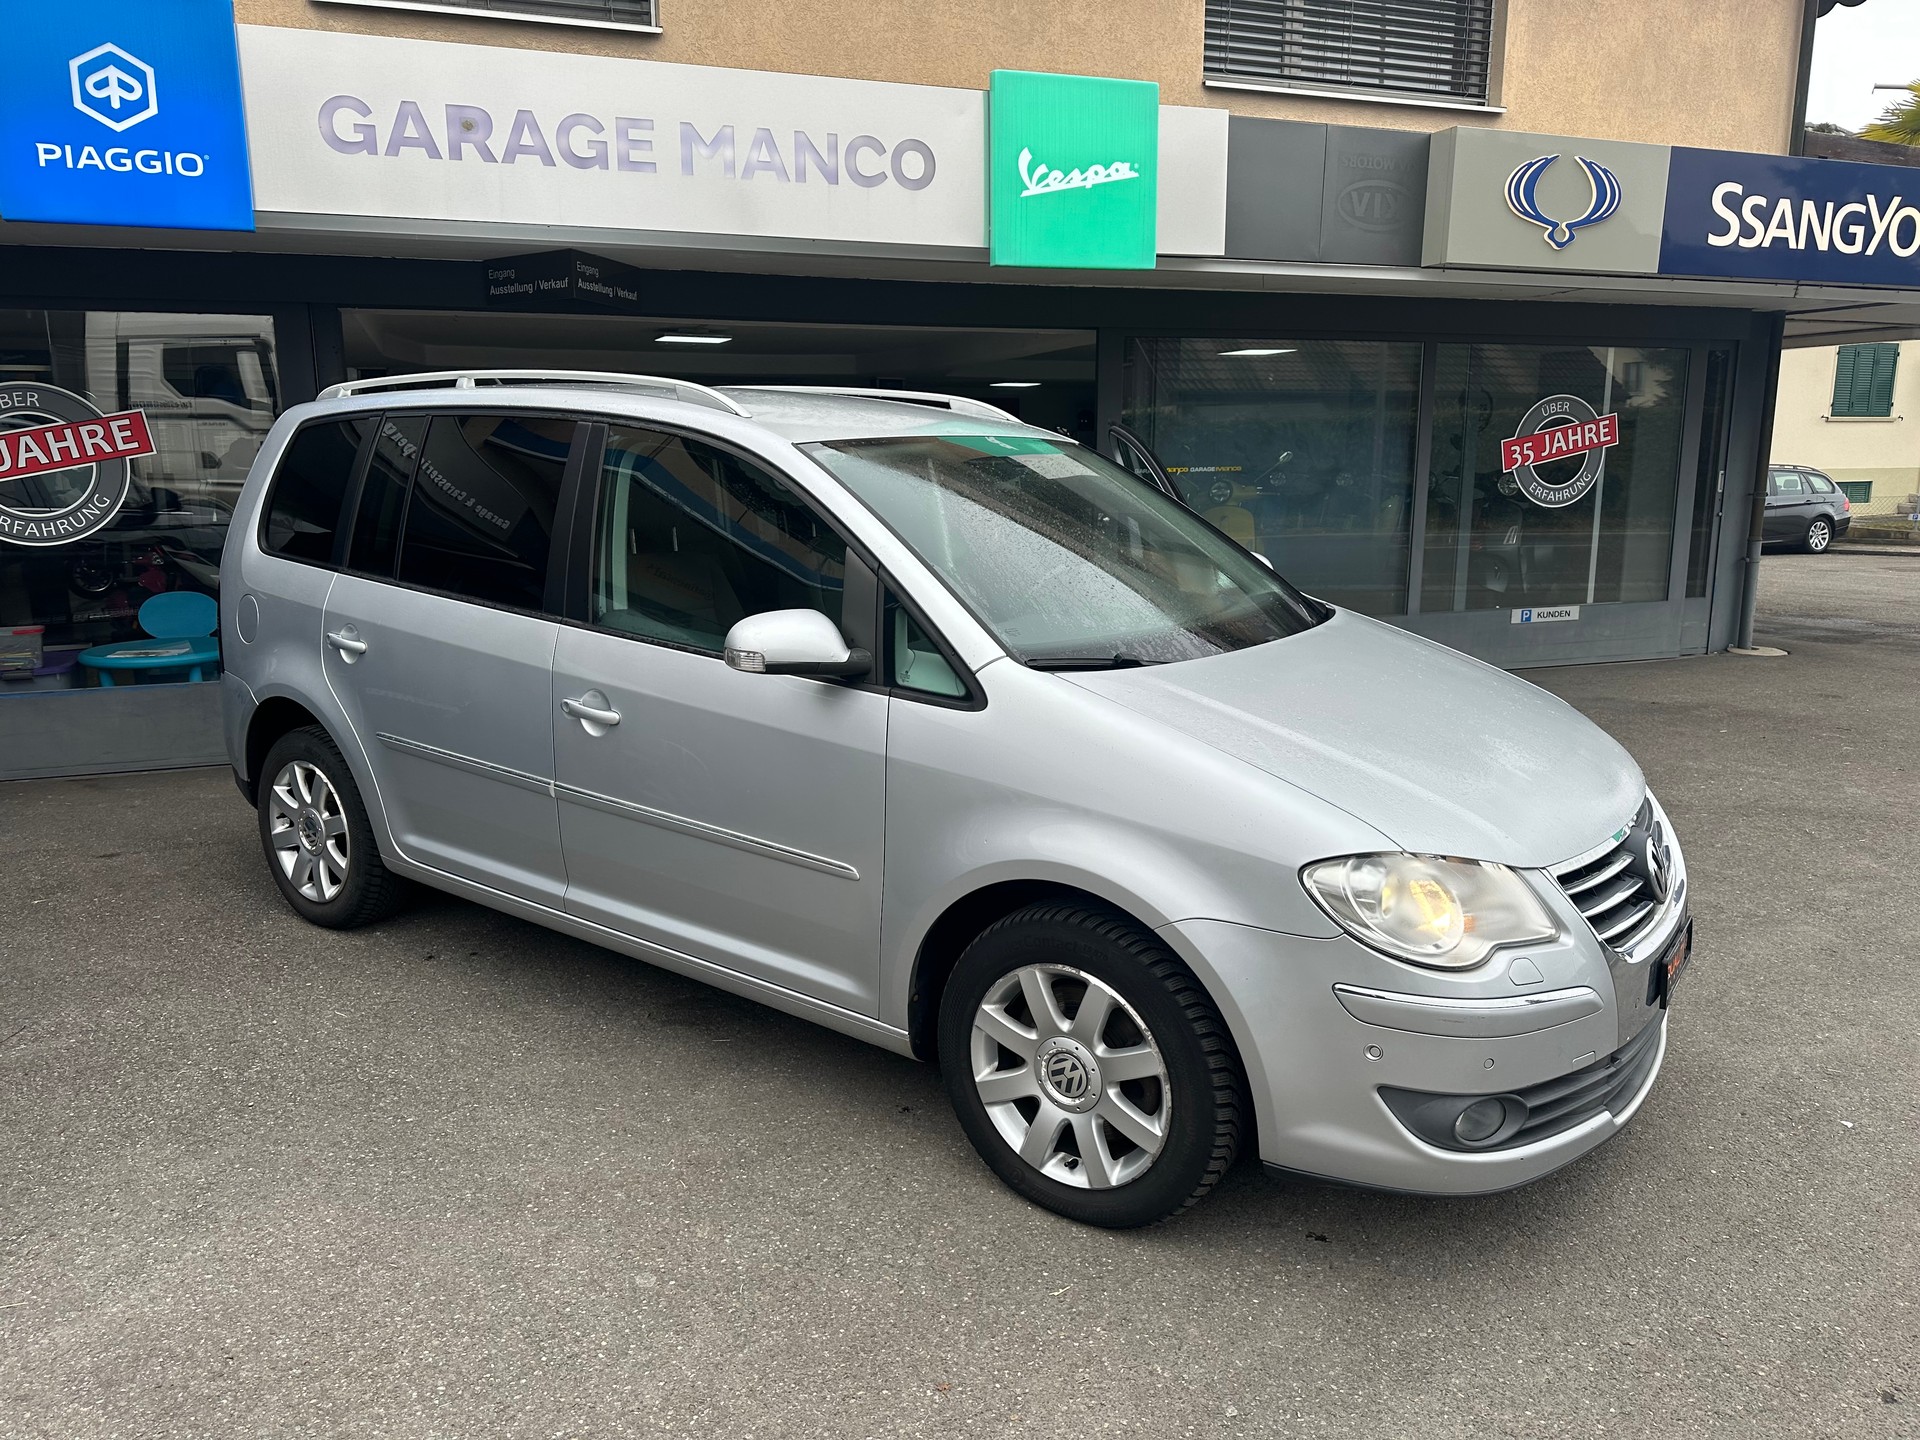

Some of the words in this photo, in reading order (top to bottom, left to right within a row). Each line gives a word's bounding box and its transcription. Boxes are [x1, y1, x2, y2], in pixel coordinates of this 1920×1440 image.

[317, 94, 657, 173] GARAGE
[679, 121, 937, 191] MANCO
[35, 142, 204, 177] PIAGGIO
[1018, 146, 1139, 197] Vespa
[488, 269, 515, 280] Eingang
[576, 261, 599, 278] Eingang
[490, 281, 533, 295] Ausstellung
[538, 277, 569, 291] Verkauf
[577, 278, 613, 297] Ausstellung
[616, 287, 638, 300] Verkauf
[1541, 401, 1570, 416] ÜBER
[0, 418, 140, 472] JAHRE
[1510, 442, 1535, 470] 35
[1541, 420, 1612, 457] JAHRE
[1528, 471, 1592, 501] ERFAHRUNG
[1537, 610, 1571, 619] KUNDEN
